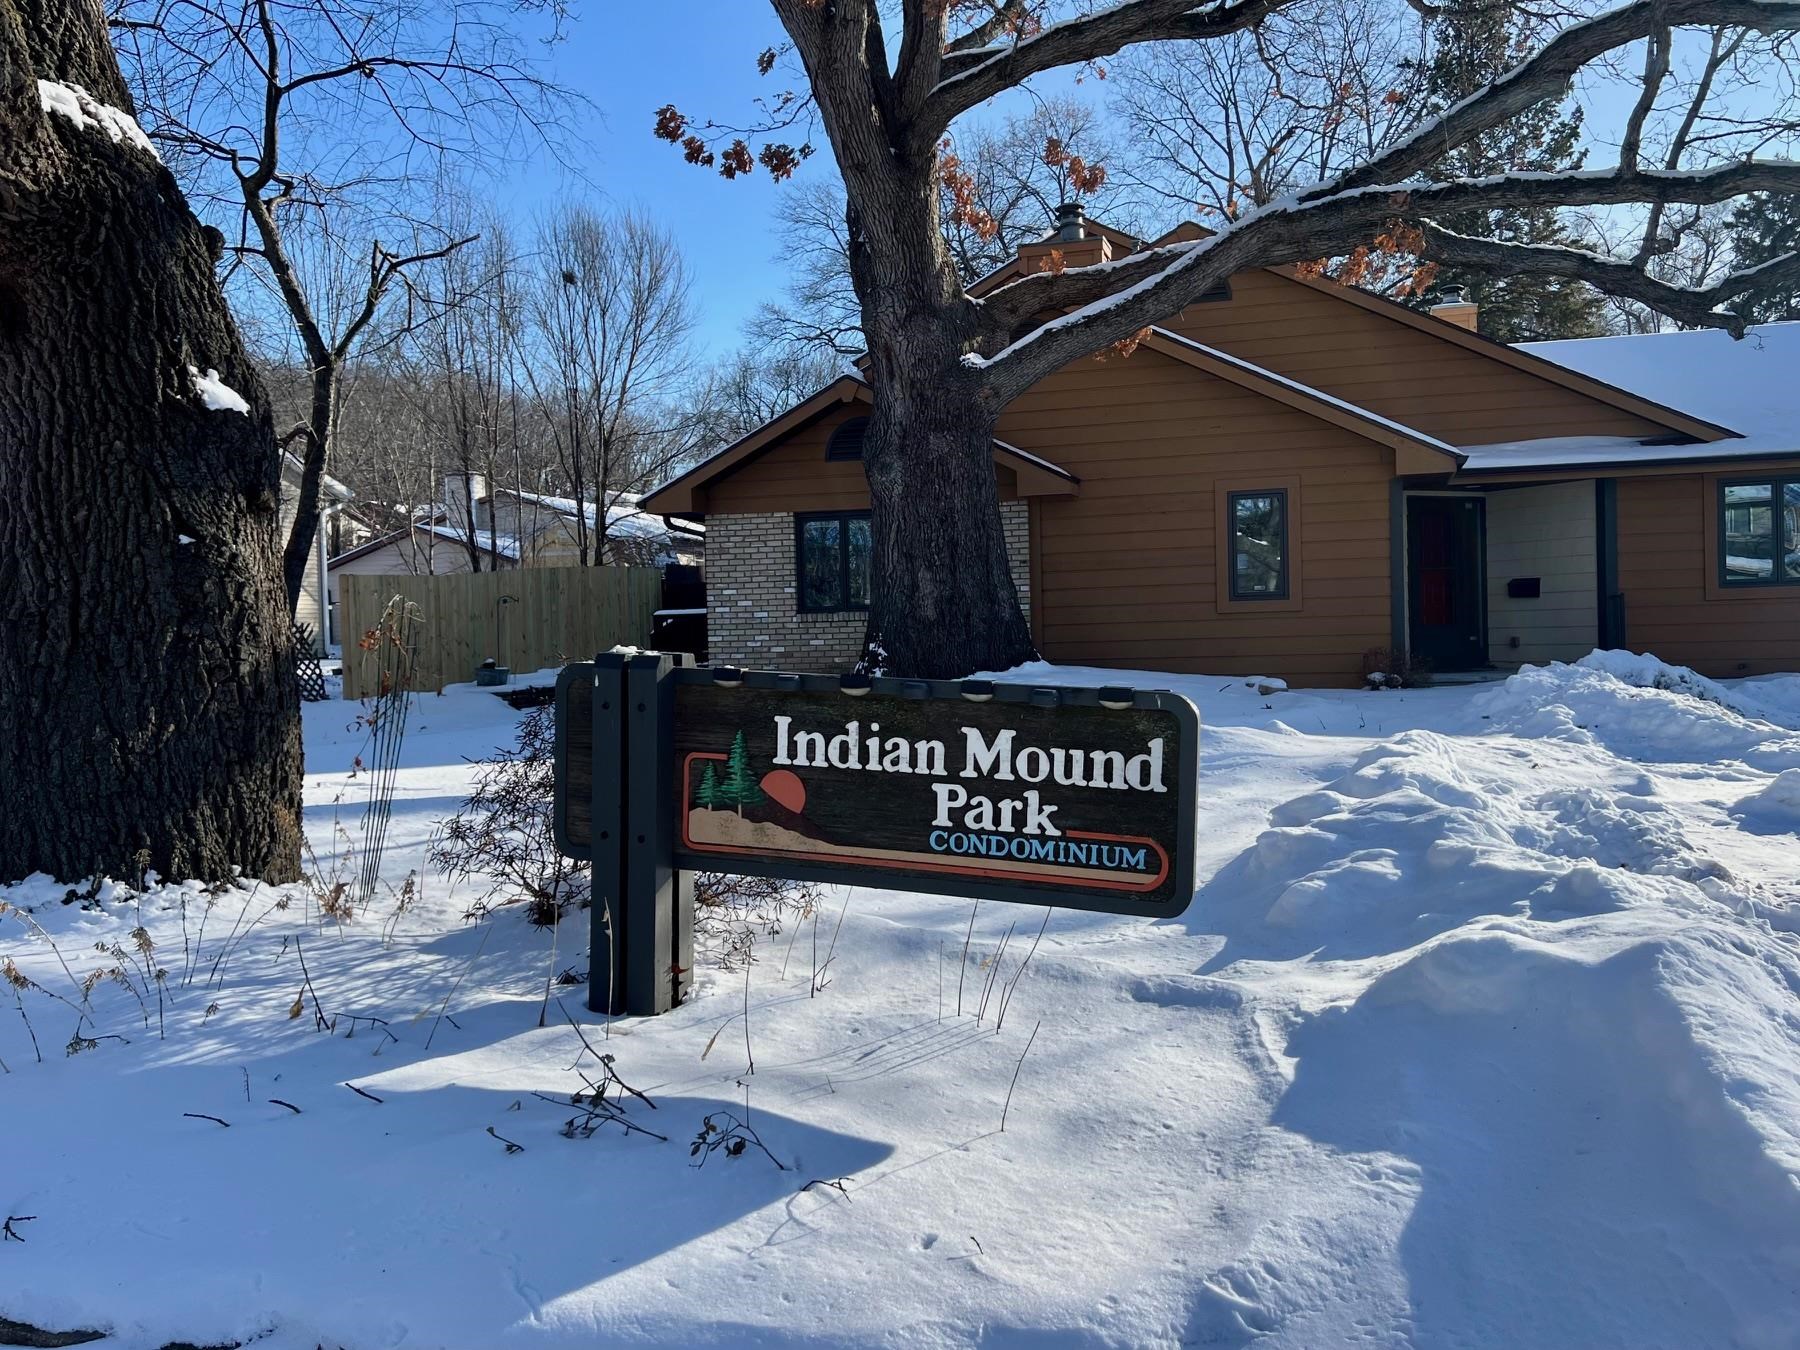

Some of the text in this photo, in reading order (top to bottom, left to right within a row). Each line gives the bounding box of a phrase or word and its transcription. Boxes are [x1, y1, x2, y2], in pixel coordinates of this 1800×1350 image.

[772, 715, 1168, 793] Indian Mound
[931, 782, 1062, 836] Park
[929, 830, 1147, 870] CONDOMINIUM
